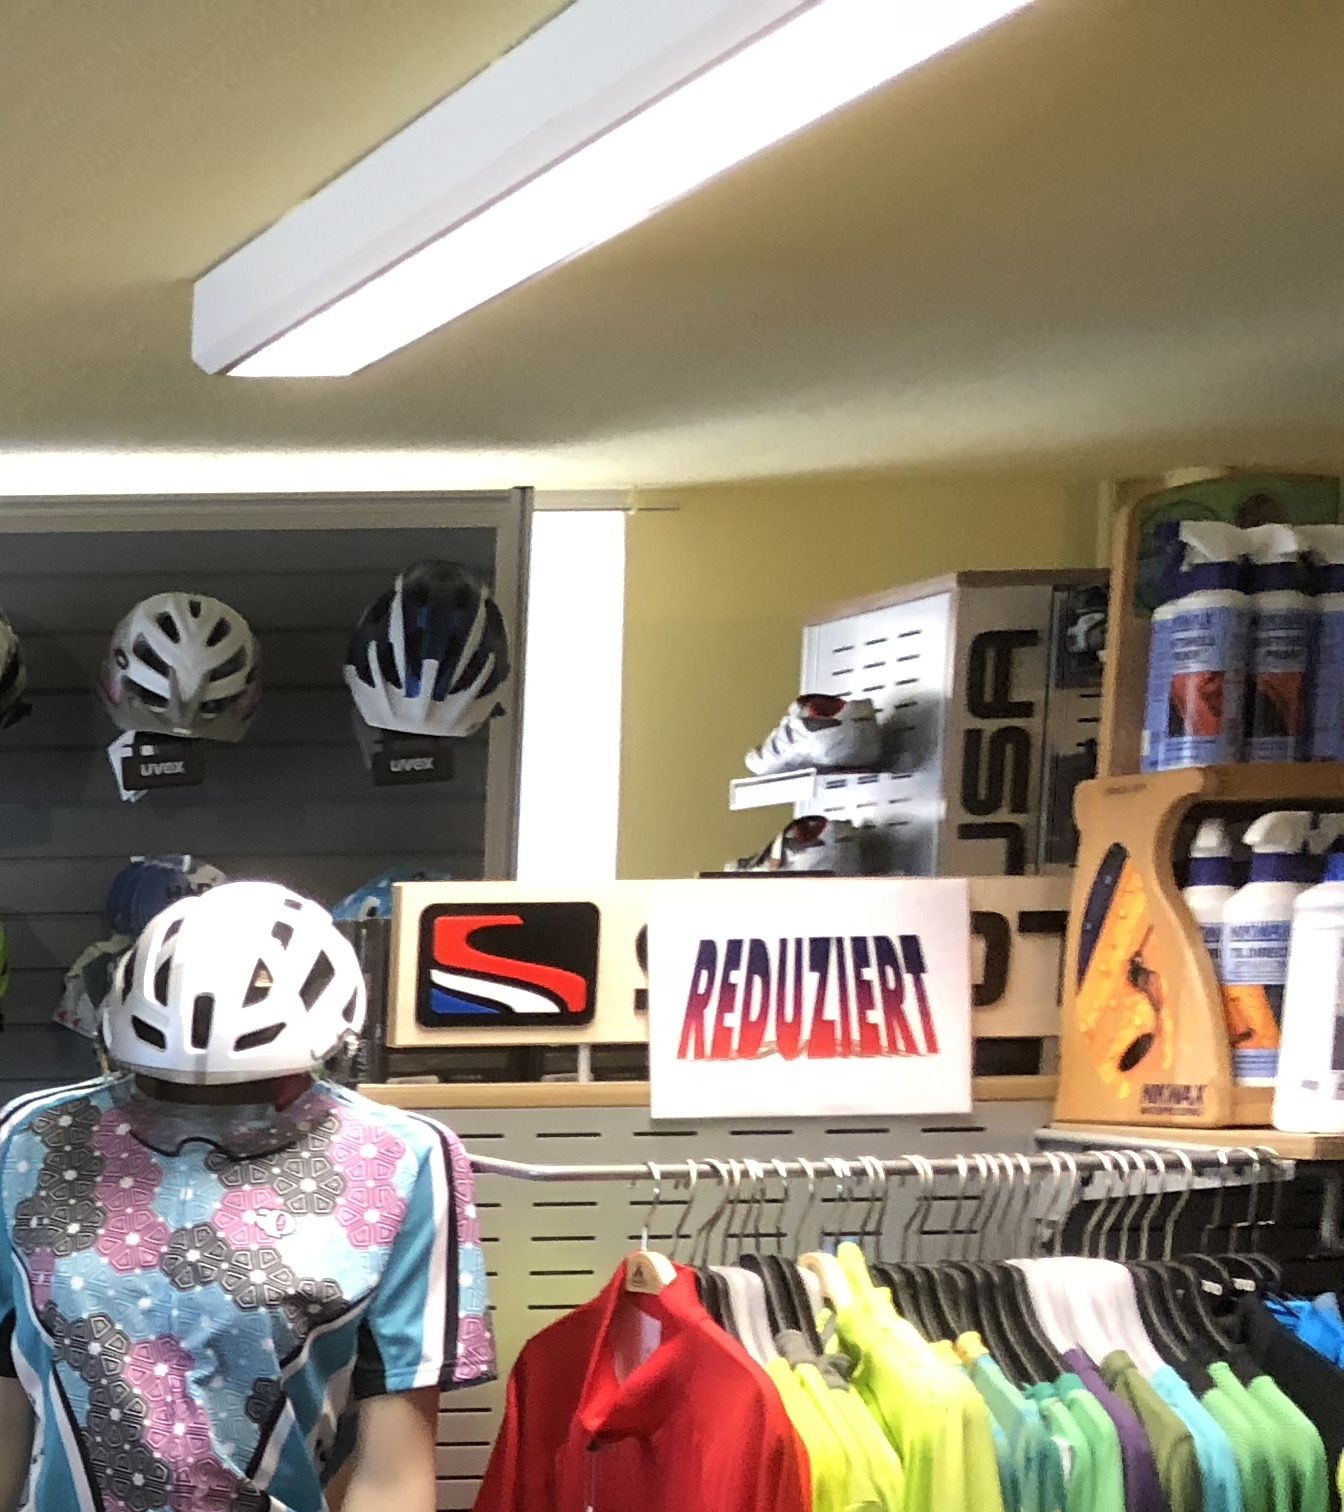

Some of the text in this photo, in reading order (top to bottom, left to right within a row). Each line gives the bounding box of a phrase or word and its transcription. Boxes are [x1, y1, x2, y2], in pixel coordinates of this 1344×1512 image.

[140, 761, 186, 777] uvex
[390, 757, 435, 772] uvex
[676, 934, 941, 1060] REDUZIERT
